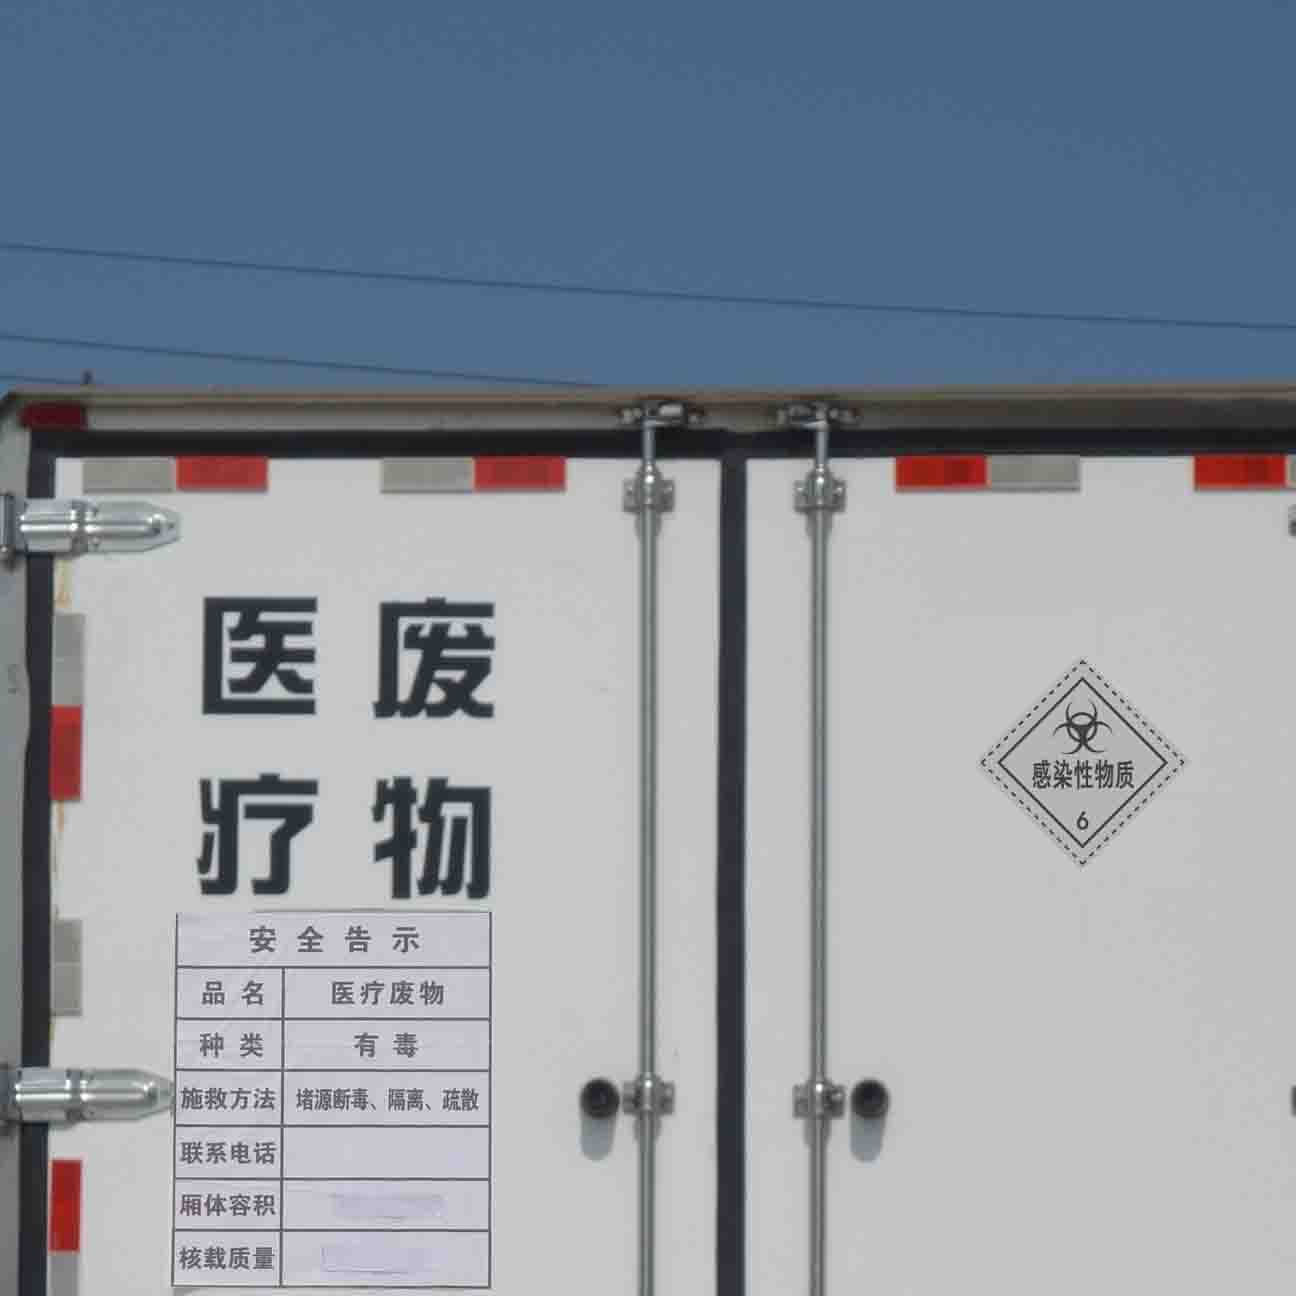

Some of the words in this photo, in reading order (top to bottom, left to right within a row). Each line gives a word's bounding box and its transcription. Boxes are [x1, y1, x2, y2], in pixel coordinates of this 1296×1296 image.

[197, 597, 319, 895] 医疗
[371, 597, 496, 900] 废物
[1031, 759, 1135, 790] 感染性物质
[1076, 811, 1090, 831] 6
[249, 926, 421, 954] 安全告示
[201, 980, 266, 1006] 品名
[331, 979, 446, 1007] 医疗废物
[199, 1032, 265, 1059] 种类
[353, 1032, 420, 1059] 有毒
[180, 1086, 276, 1112] 施救方法
[180, 1140, 277, 1165] 联系电话
[179, 1193, 276, 1217] 厢体容积
[179, 1246, 276, 1271] 核载质量
